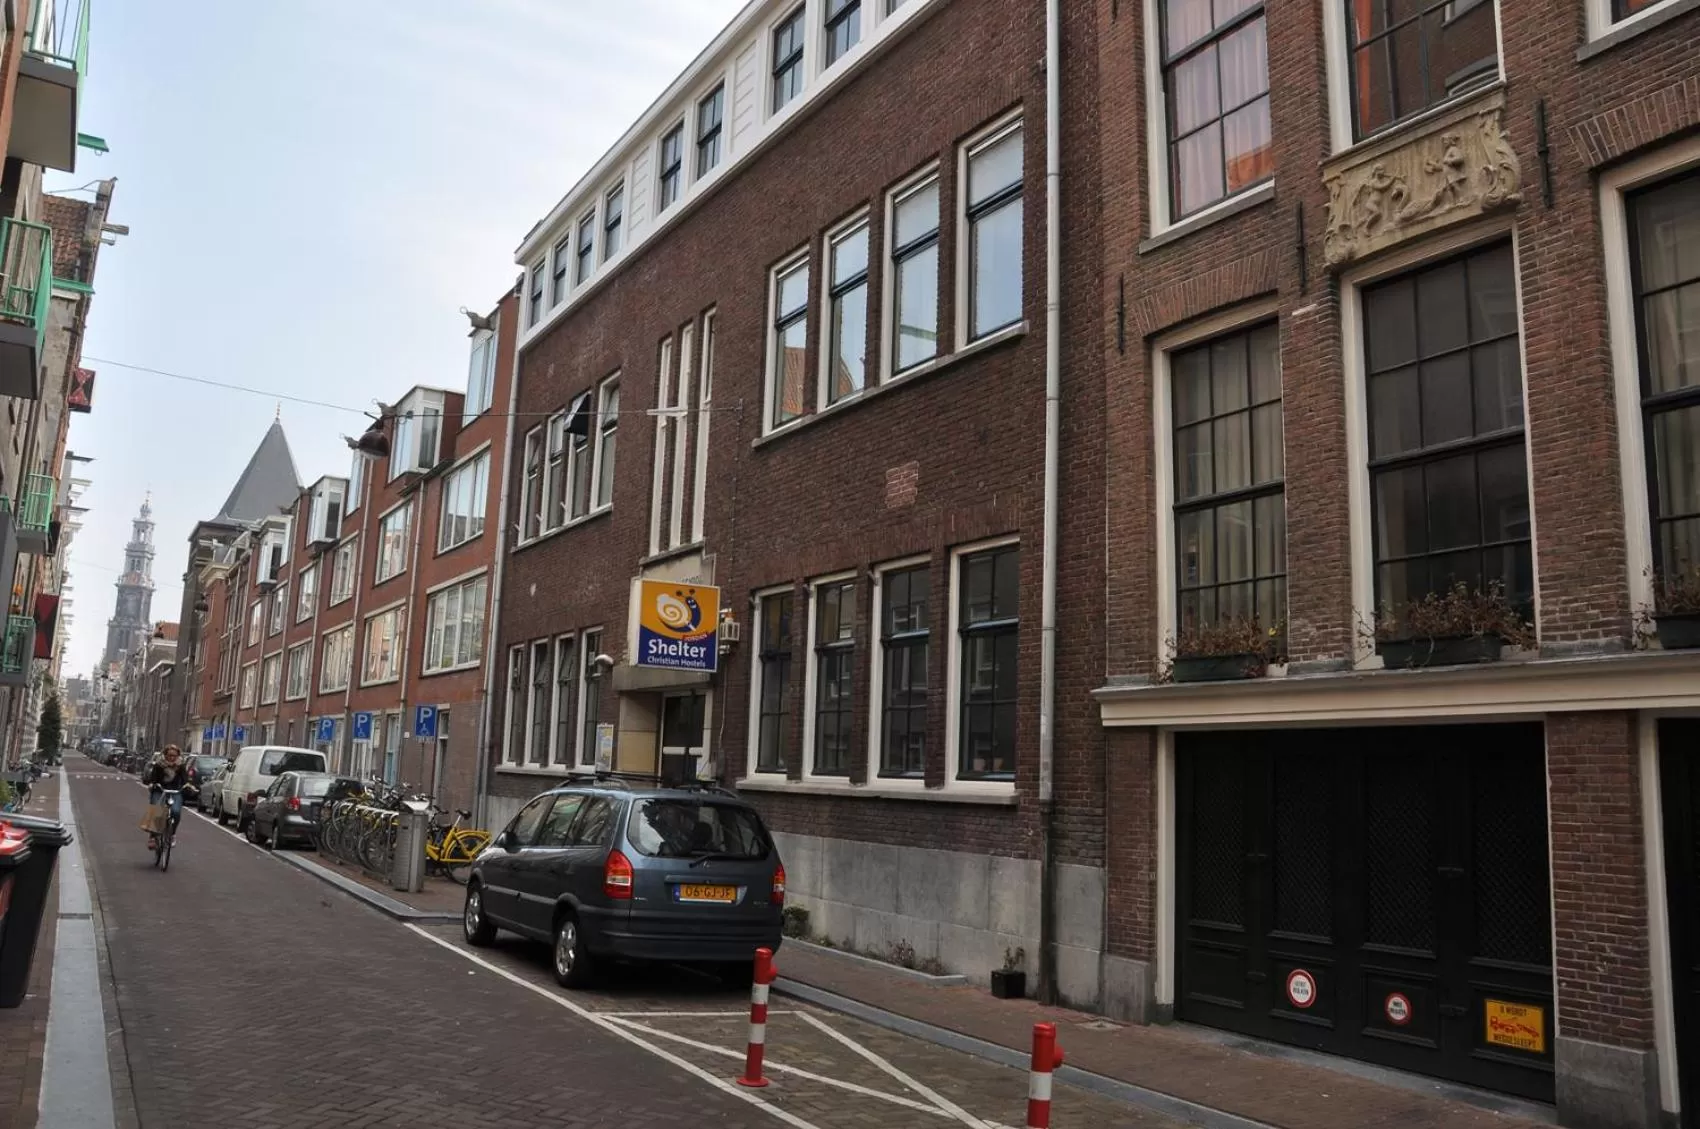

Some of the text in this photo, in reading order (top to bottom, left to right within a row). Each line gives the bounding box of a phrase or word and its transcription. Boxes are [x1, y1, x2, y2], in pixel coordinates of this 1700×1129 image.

[648, 638, 706, 658] Shelter
[647, 656, 706, 668] Christian Hostels
[357, 714, 368, 729] P
[420, 707, 433, 723] P
[322, 719, 332, 731] P
